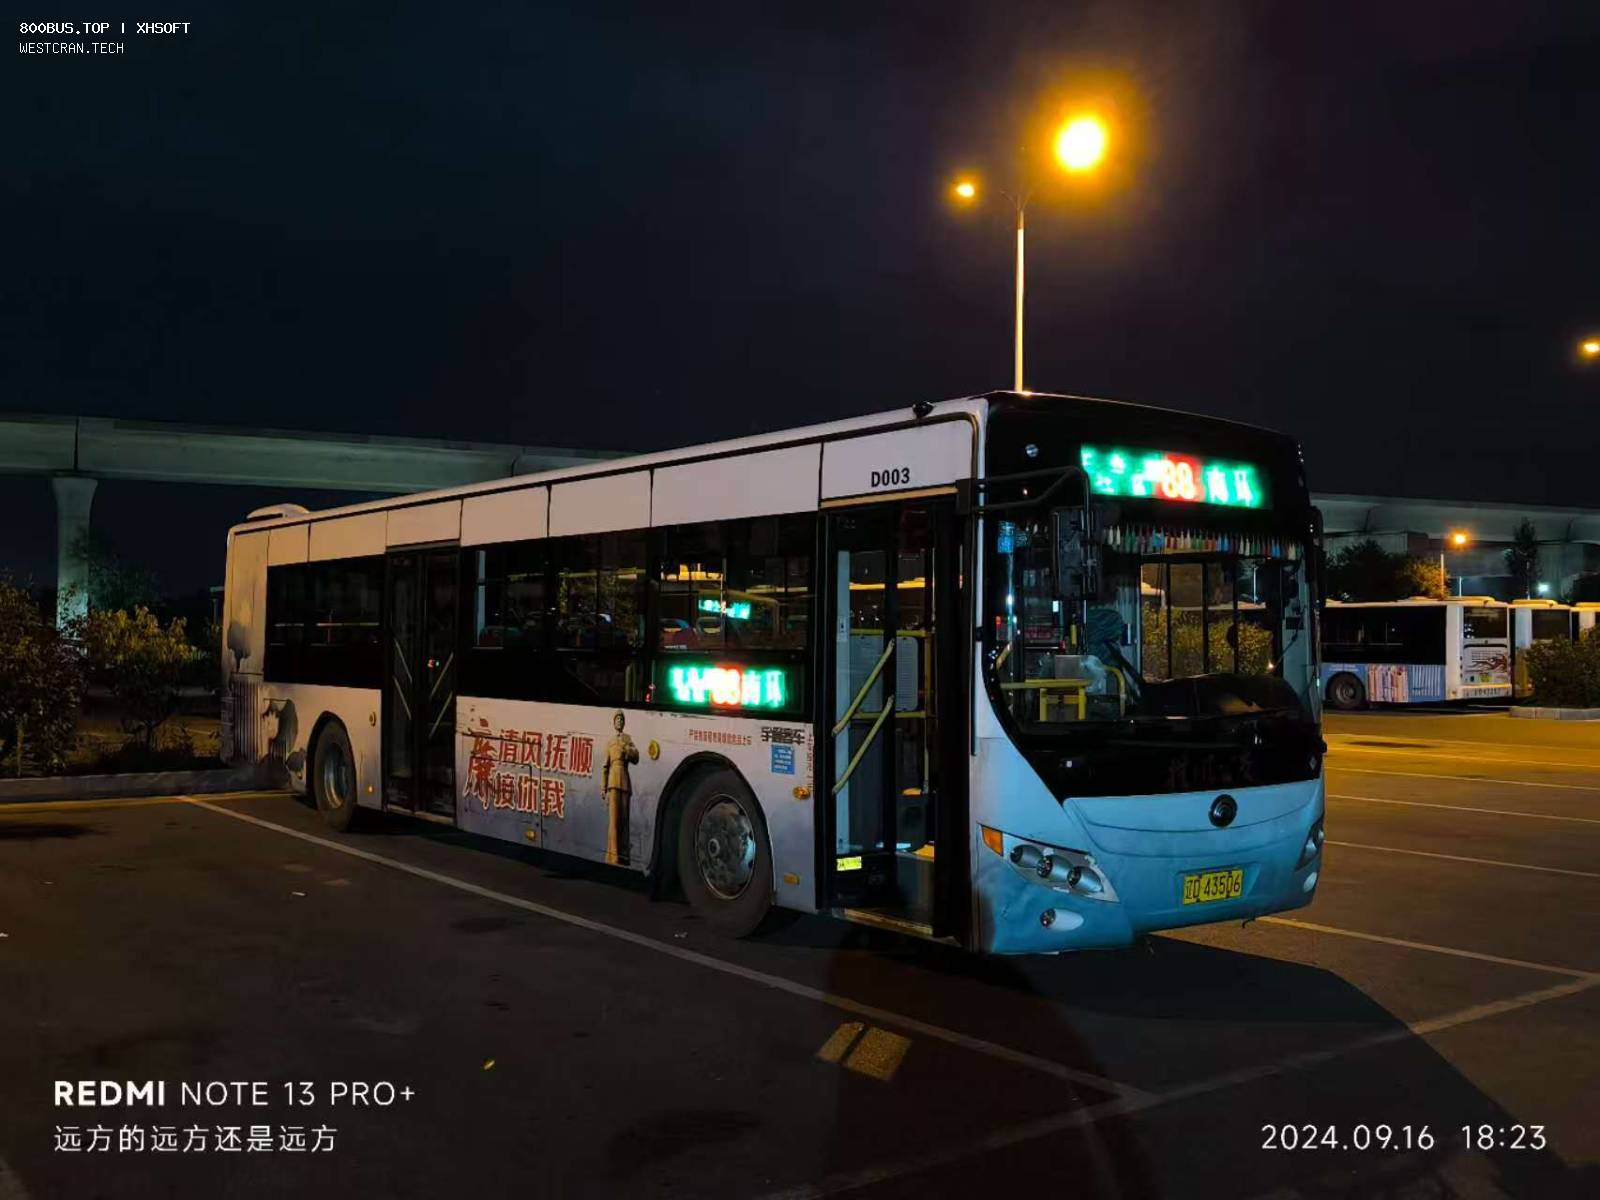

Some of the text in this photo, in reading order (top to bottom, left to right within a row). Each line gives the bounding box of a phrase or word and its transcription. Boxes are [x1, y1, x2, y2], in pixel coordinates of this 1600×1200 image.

[871, 468, 910, 488] D003
[500, 729, 594, 776] 清风抚顺
